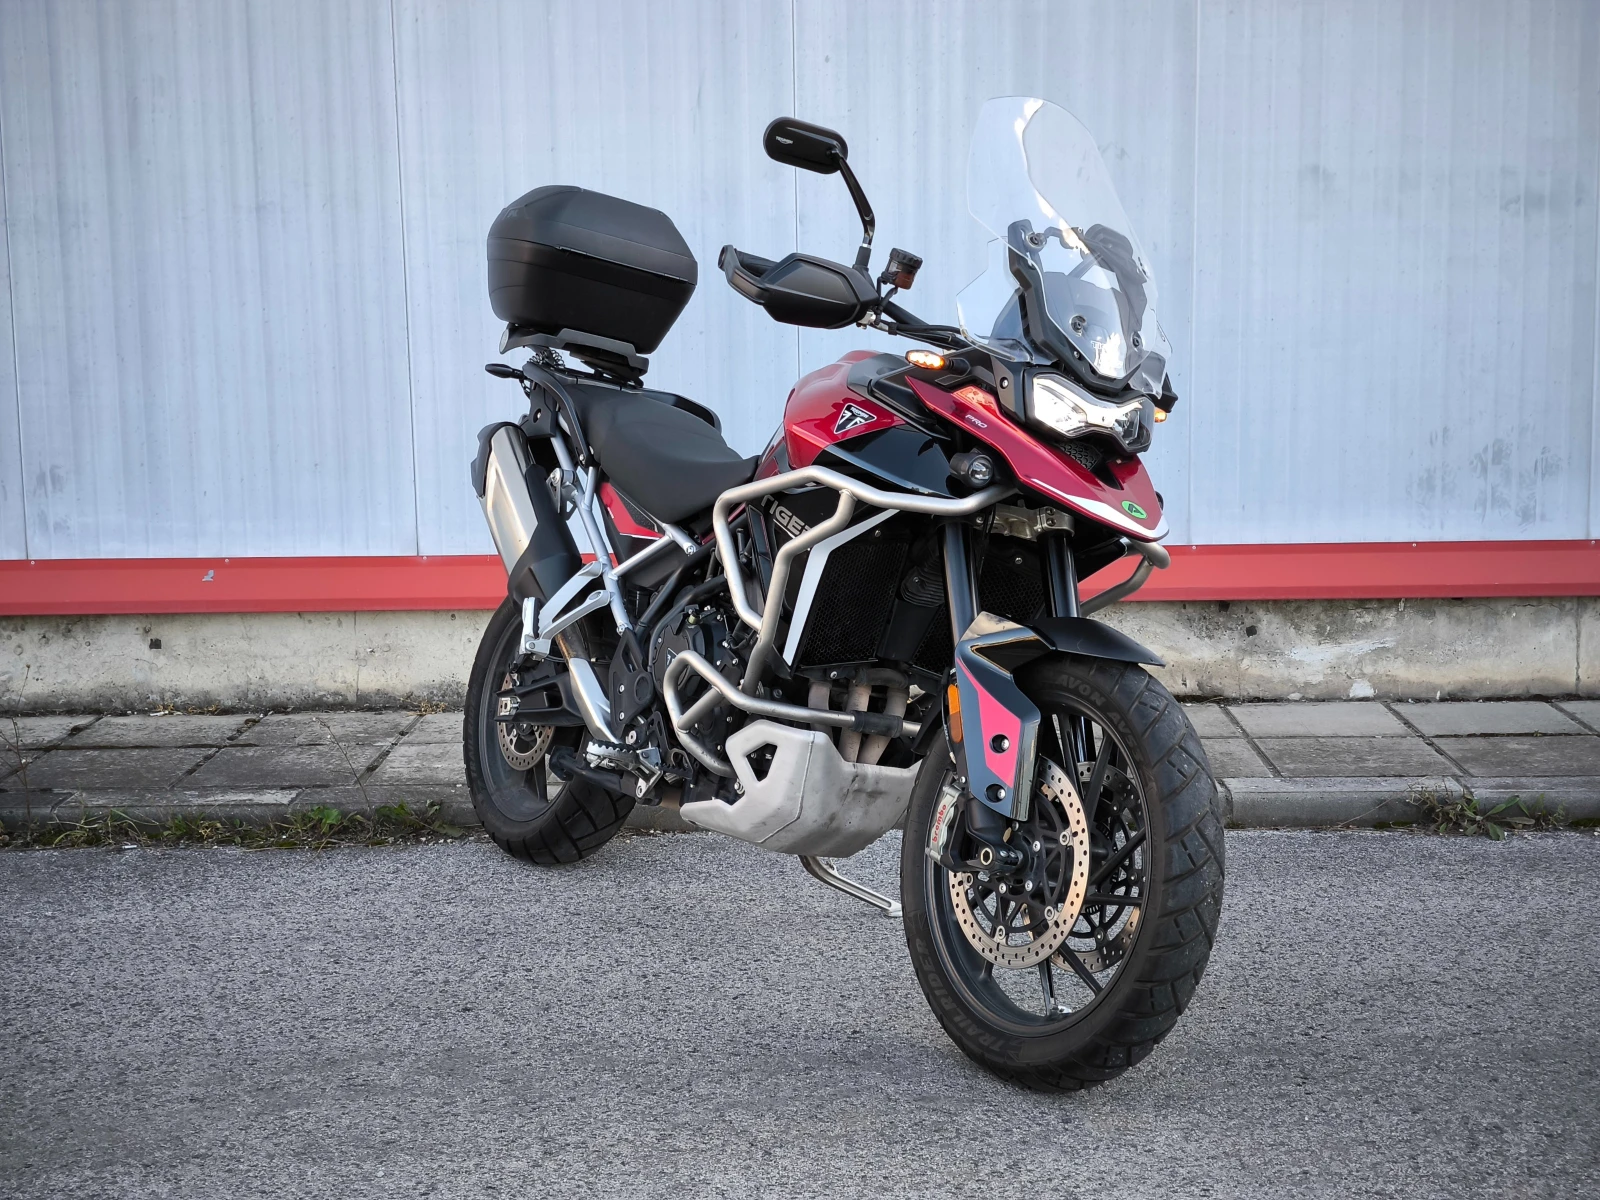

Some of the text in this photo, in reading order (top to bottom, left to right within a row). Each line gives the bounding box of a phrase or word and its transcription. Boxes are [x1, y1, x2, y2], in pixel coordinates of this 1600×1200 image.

[965, 414, 988, 429] PRO
[1054, 674, 1108, 707] AVON
[932, 804, 947, 843] brembo
[915, 938, 1005, 1052] TRAILRIDER
